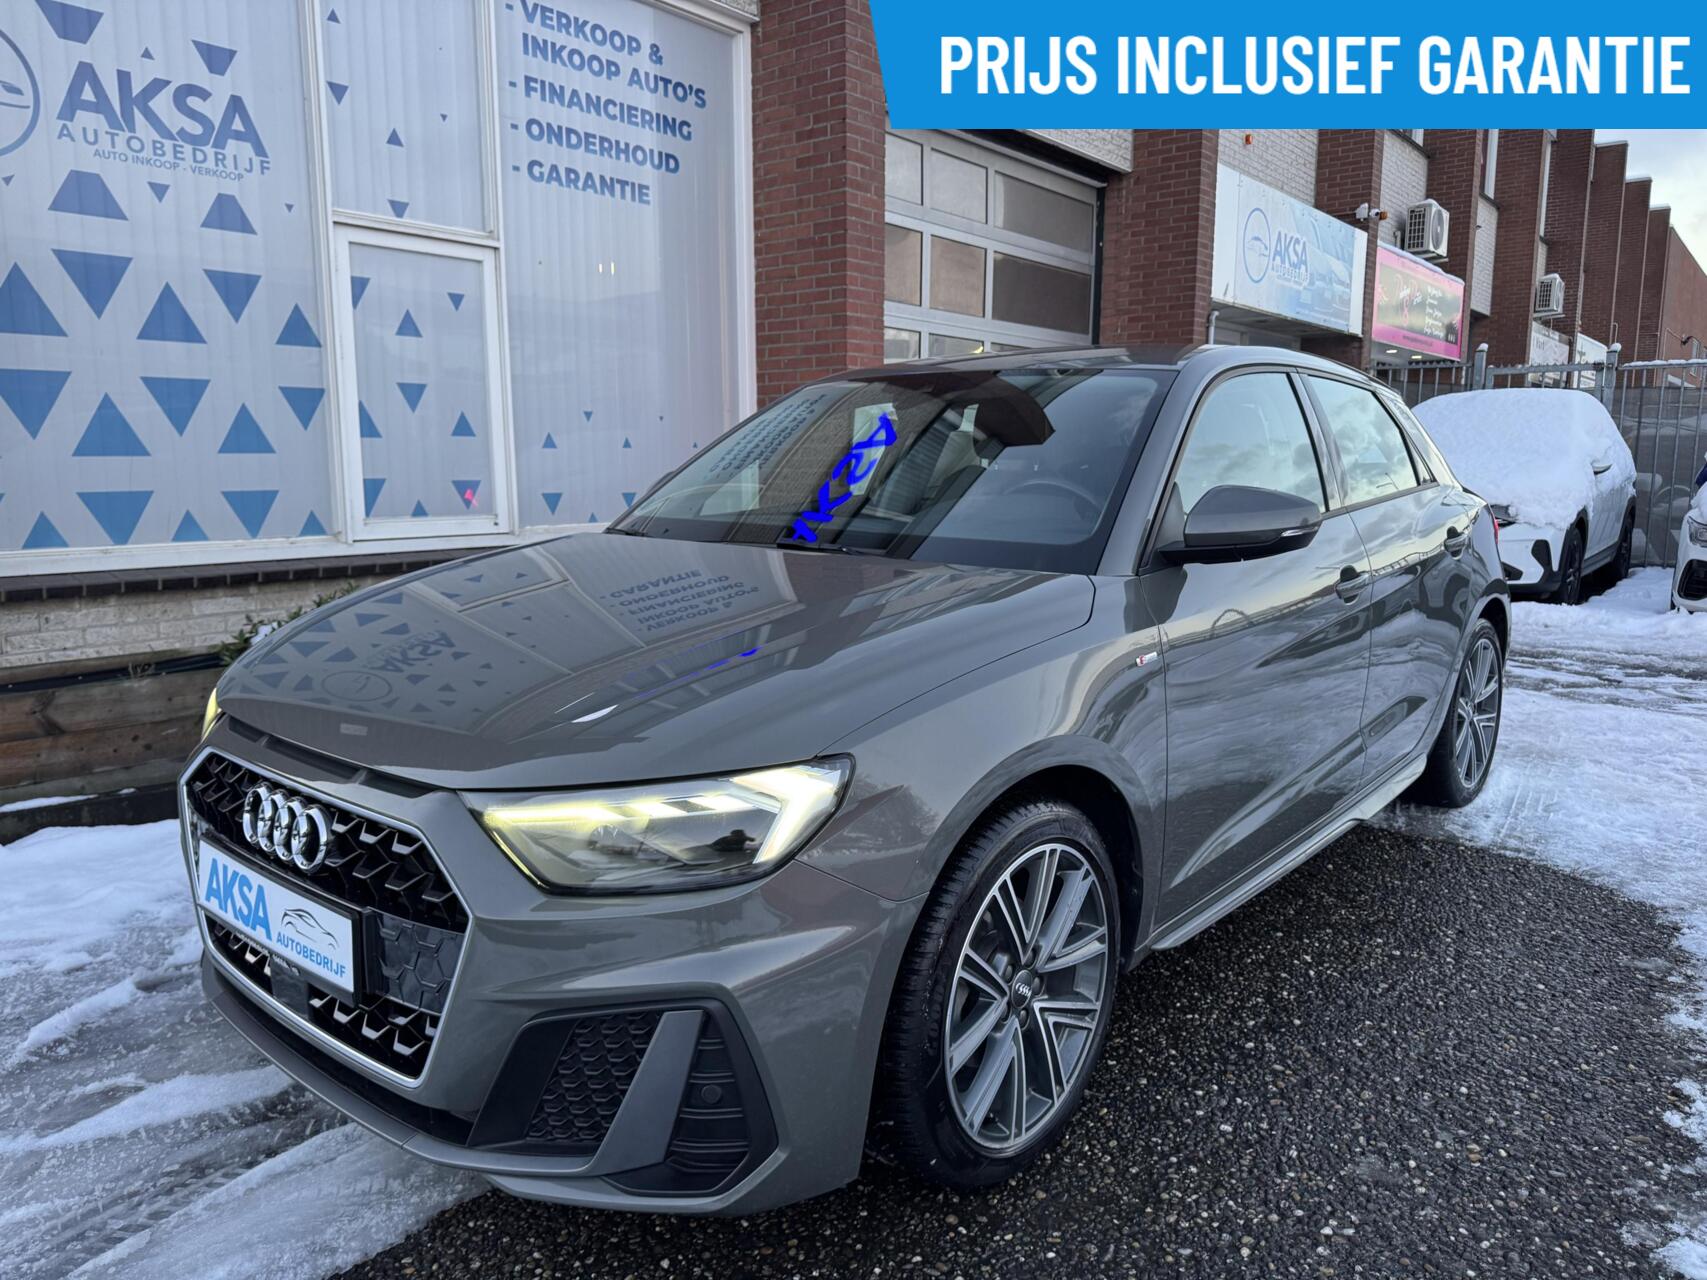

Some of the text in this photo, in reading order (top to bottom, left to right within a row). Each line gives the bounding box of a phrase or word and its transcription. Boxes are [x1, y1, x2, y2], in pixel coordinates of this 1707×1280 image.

[520, 0, 641, 56] VERKOOP
[648, 43, 663, 66] &
[522, 32, 706, 109] INKOOP AUTO'S
[56, 61, 269, 158] AKSA
[524, 74, 692, 141] FINANCIERING
[57, 123, 271, 175] AUTOBEDRIJF
[93, 148, 128, 162] AUTO
[131, 154, 180, 171] INKOOP
[190, 165, 244, 182] VERKOOP
[525, 118, 680, 174] ONDERHOUD
[527, 159, 650, 205] GARANTIE
[1272, 231, 1308, 273] AKSA
[204, 858, 272, 942] AKSA
[276, 931, 347, 979] AUTOBEDRIJF
